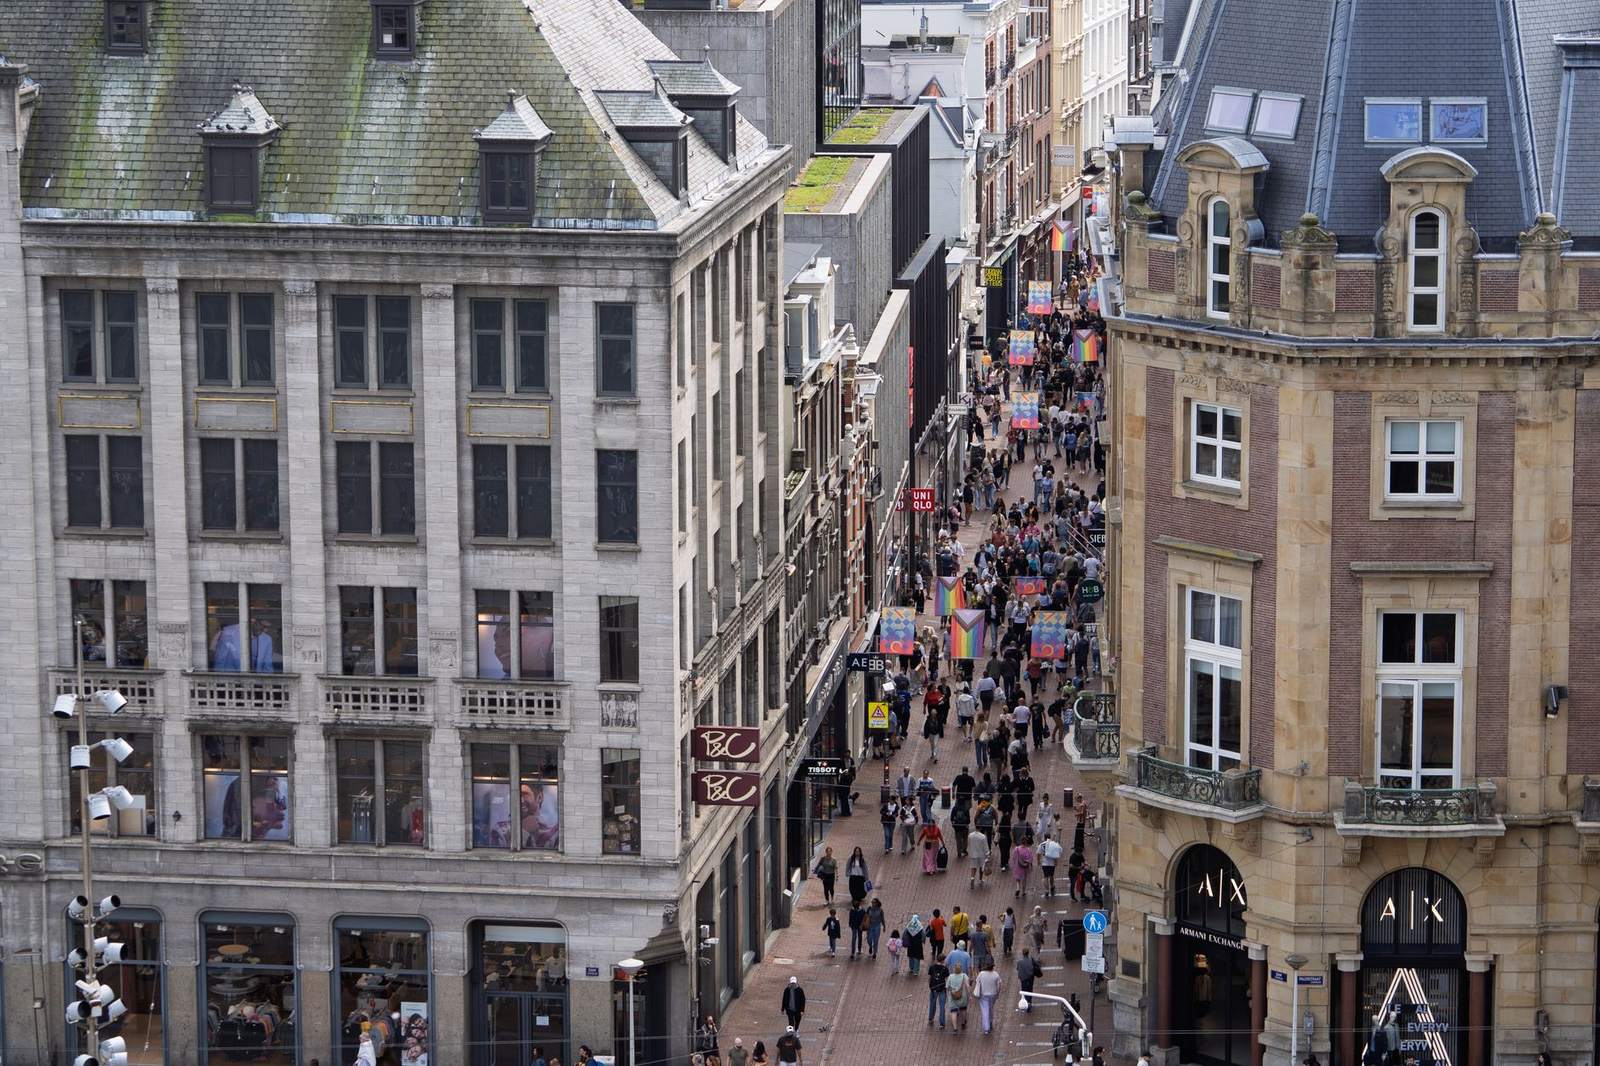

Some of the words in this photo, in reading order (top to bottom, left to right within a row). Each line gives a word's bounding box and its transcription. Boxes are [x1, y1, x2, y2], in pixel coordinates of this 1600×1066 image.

[913, 491, 930, 500] UNI
[913, 500, 932, 510] QLO
[700, 730, 757, 759] P&C
[701, 774, 758, 802] P&C
[1180, 927, 1207, 940] ARMANI
[1208, 934, 1246, 951] EXCHANGE
